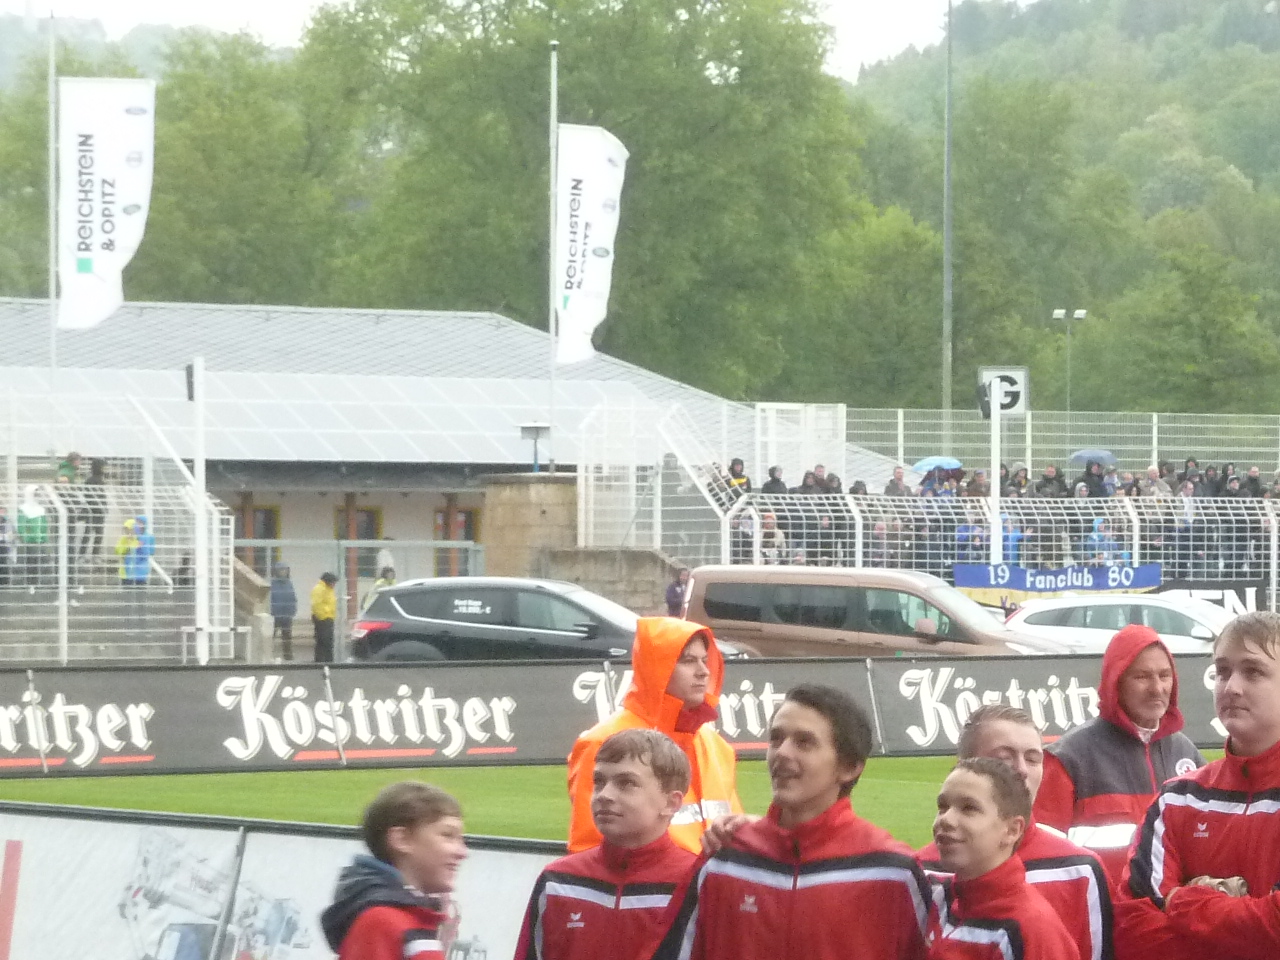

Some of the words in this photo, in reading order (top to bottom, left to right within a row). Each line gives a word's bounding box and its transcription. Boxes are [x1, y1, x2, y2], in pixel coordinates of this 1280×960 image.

[101, 177, 117, 236] OPITZ
[101, 238, 116, 253] &
[991, 375, 1021, 410] G
[987, 565, 1010, 585] 19
[1025, 569, 1094, 588] Fanclub
[1108, 566, 1134, 586] 80
[216, 675, 518, 760] Köstritzer
